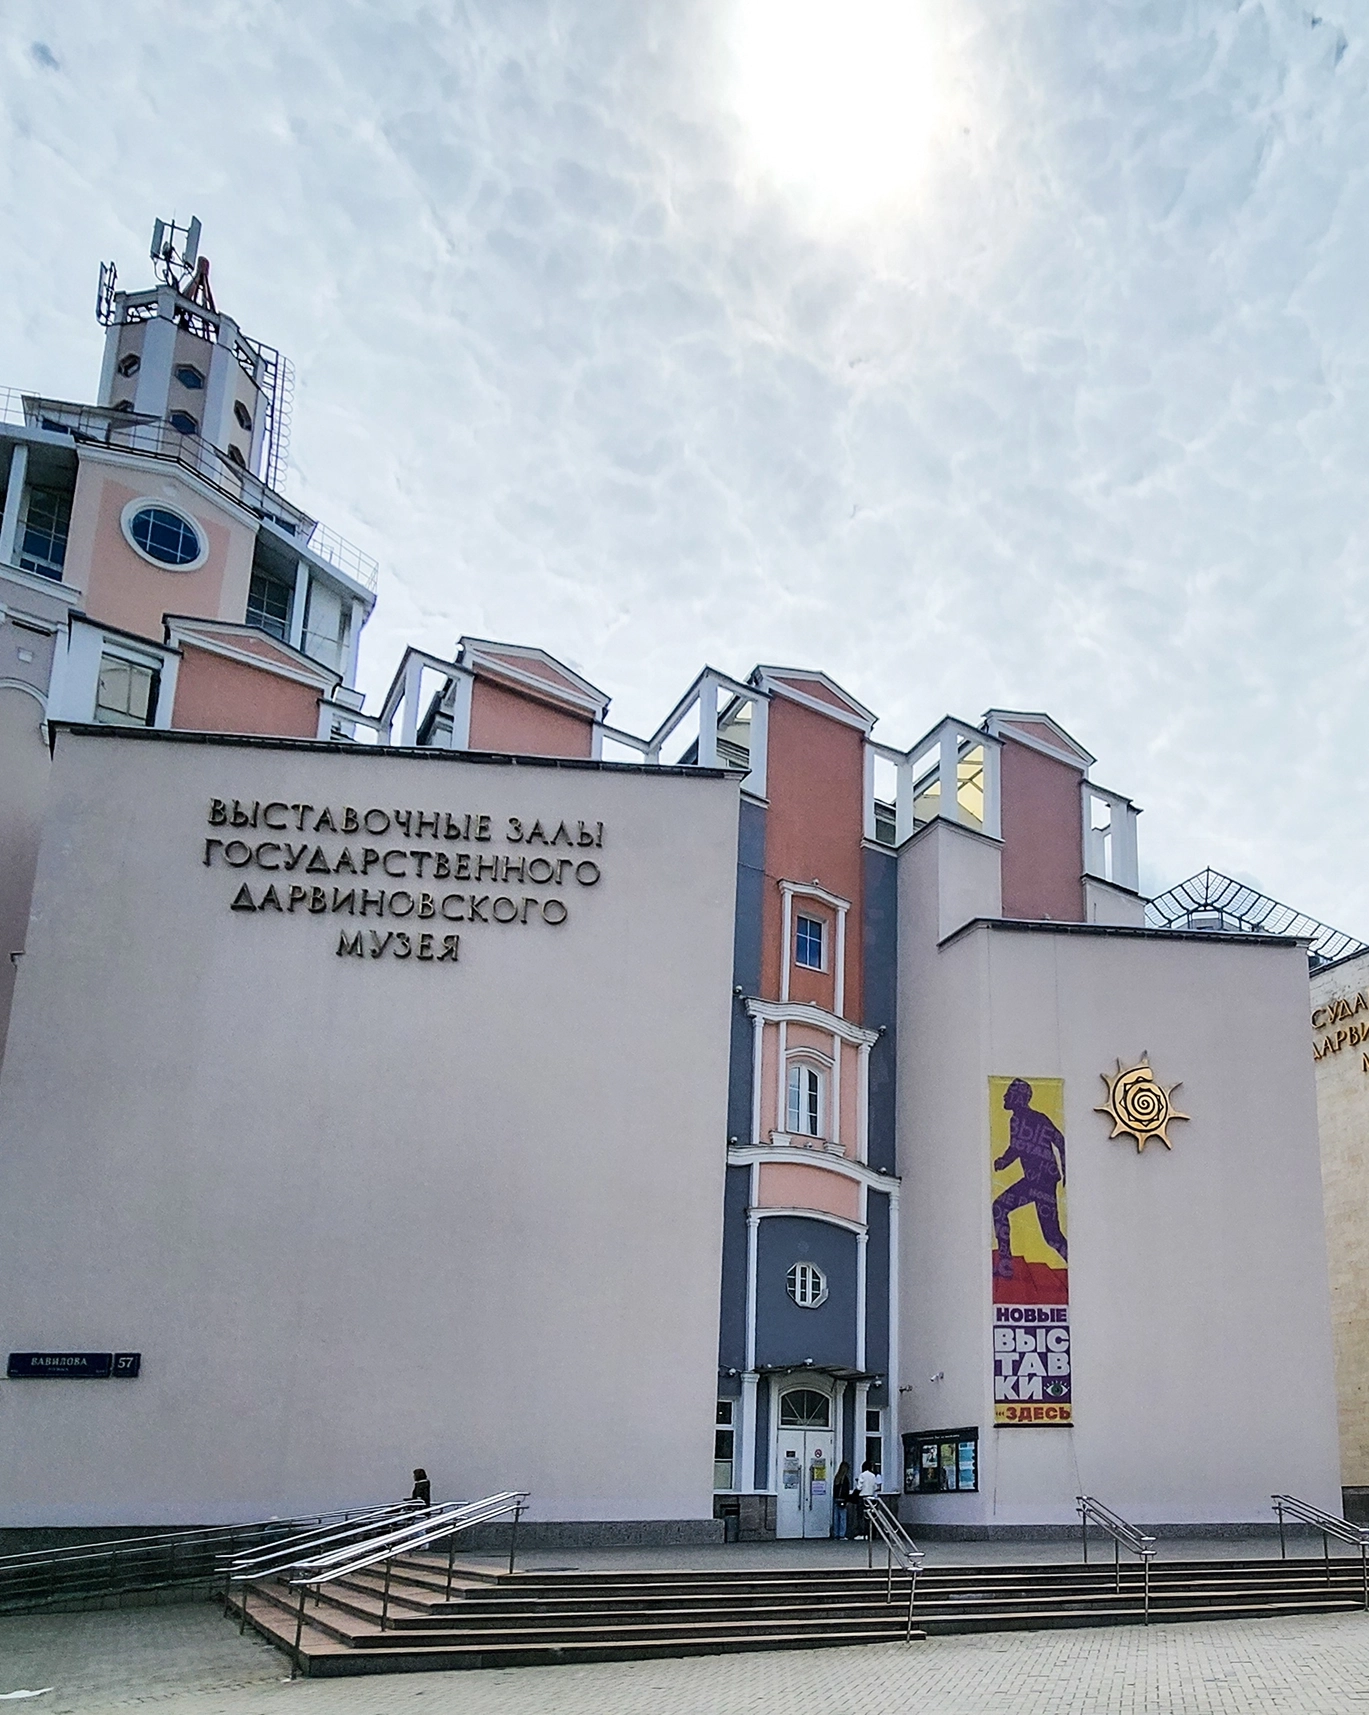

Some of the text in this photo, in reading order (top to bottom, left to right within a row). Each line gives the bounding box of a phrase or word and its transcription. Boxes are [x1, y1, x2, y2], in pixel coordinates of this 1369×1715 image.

[207, 797, 605, 848] ВЫСТАВОЧНЫЕ ЗАЛЫ
[202, 838, 602, 886] ГОСУДАРСТВЕННОГО
[230, 882, 569, 925] ДАРВИНОВСКОГО
[336, 929, 461, 962] МУЗЕЯ
[1312, 992, 1369, 1029] СУДА
[996, 1307, 1067, 1323] НОВЫЕ
[994, 1327, 1070, 1353] ВЫС
[31, 1357, 87, 1366] ВАВИЛОВА
[117, 1357, 134, 1368] 57
[994, 1352, 1070, 1376] ТАВ
[995, 1376, 1043, 1400] КИ
[1006, 1406, 1070, 1422] ЗДЕСЬ
